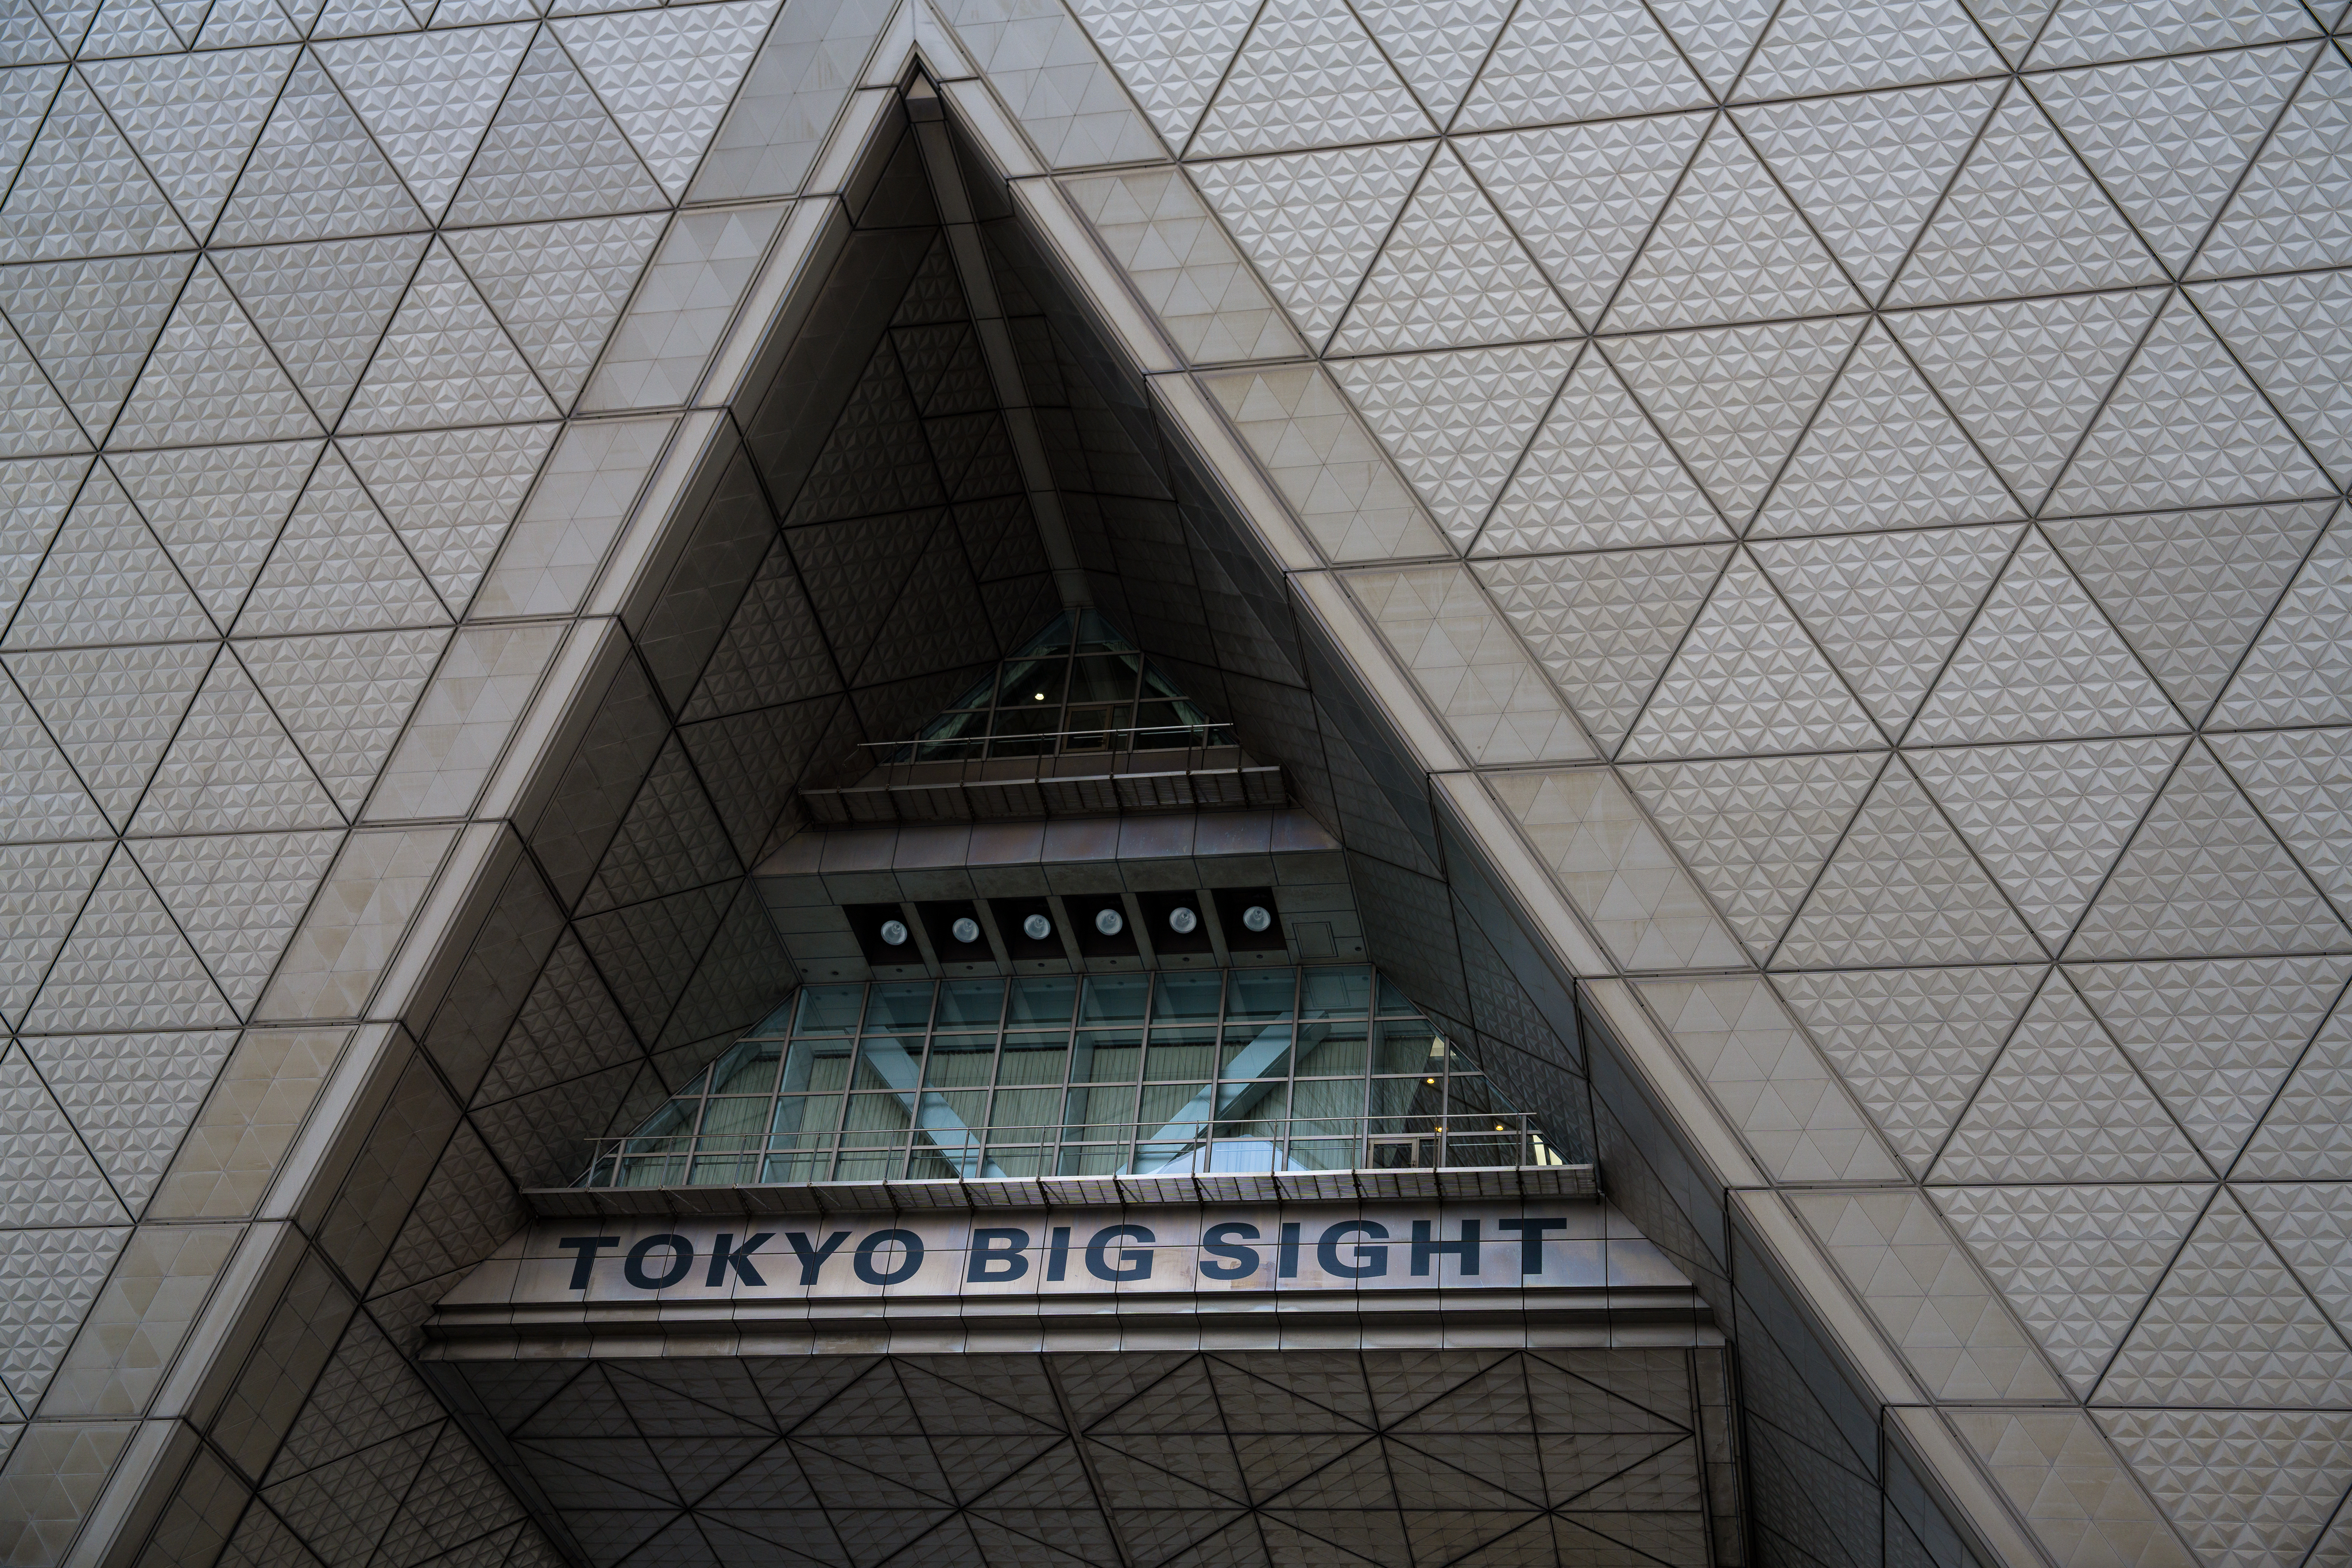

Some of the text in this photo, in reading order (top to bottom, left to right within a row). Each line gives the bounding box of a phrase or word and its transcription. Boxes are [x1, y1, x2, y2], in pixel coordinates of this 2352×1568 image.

[559, 1217, 1567, 1290] TOKYO BIG SIGHT
